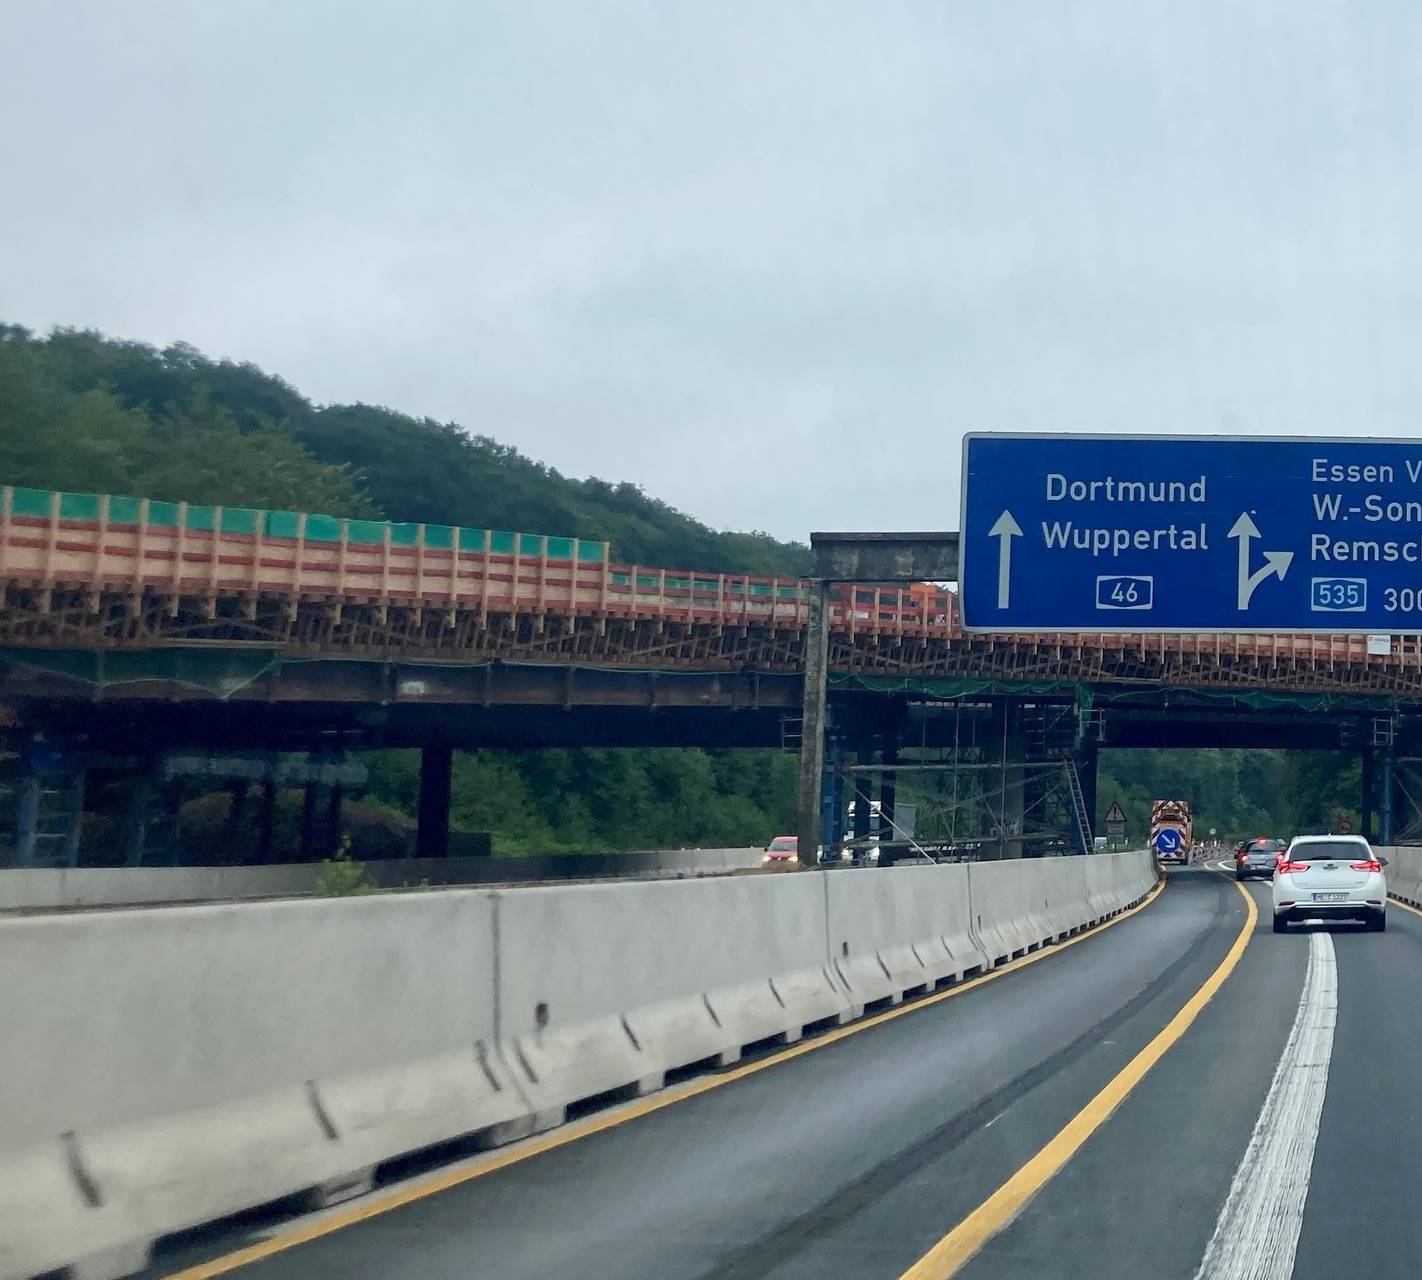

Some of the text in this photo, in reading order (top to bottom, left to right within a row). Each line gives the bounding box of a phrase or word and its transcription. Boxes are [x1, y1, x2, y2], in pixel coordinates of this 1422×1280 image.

[1311, 457, 1395, 484] Essen
[1045, 472, 1207, 504] Dortmund
[1040, 520, 1209, 557] Wuppertal
[1110, 583, 1139, 604] 46
[1318, 584, 1360, 606] 535
